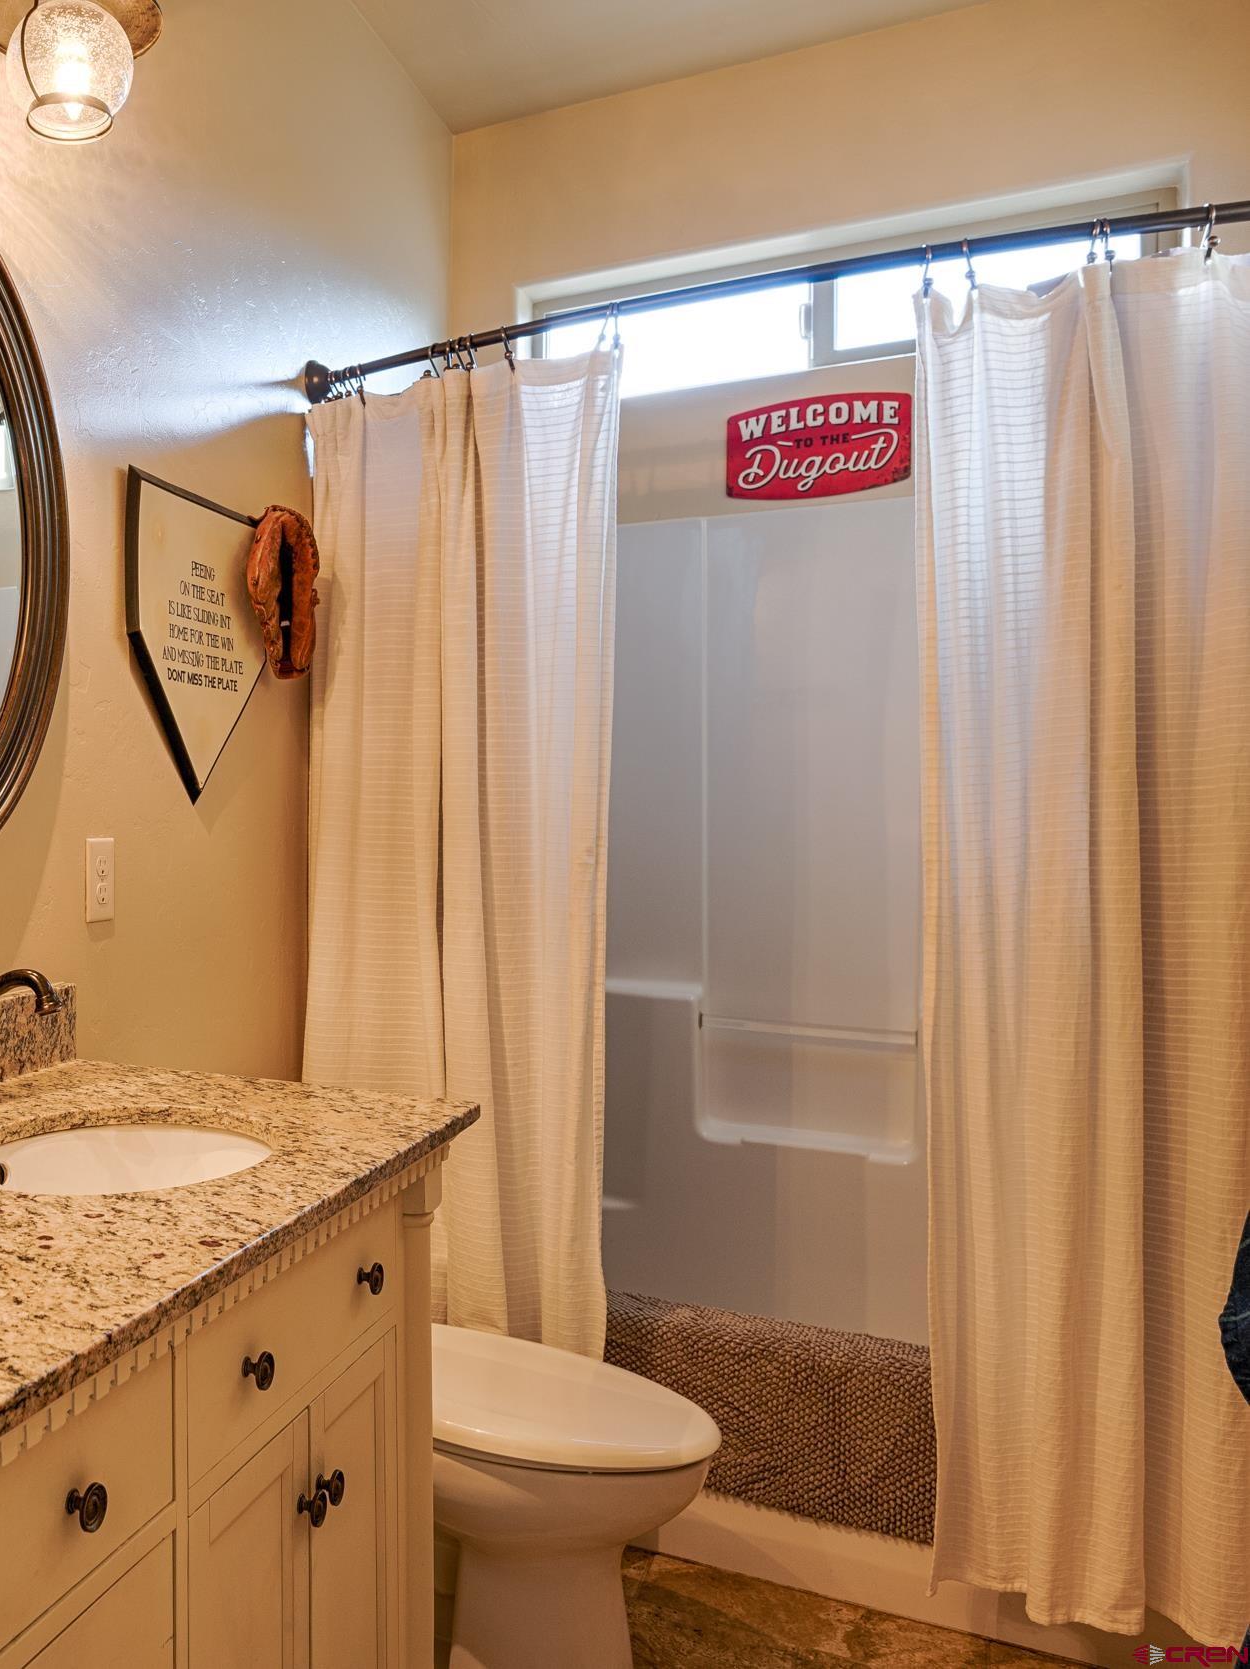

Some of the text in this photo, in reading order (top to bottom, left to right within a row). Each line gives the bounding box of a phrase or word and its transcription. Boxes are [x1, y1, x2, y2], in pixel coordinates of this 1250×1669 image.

[738, 400, 901, 442] WELCOME
[794, 433, 850, 449] TO THE
[737, 428, 899, 492] Dugout
[191, 560, 216, 581] PEEING
[180, 580, 225, 607] ON THE SEAT
[168, 600, 175, 615] IS
[176, 602, 192, 620] LIKE
[193, 607, 219, 626] SLIDING
[169, 623, 234, 651] HOME FOR THE WIN
[162, 645, 244, 675] AND MISSING THE PLATE
[167, 667, 238, 692] DONT MISS THE PLATE
